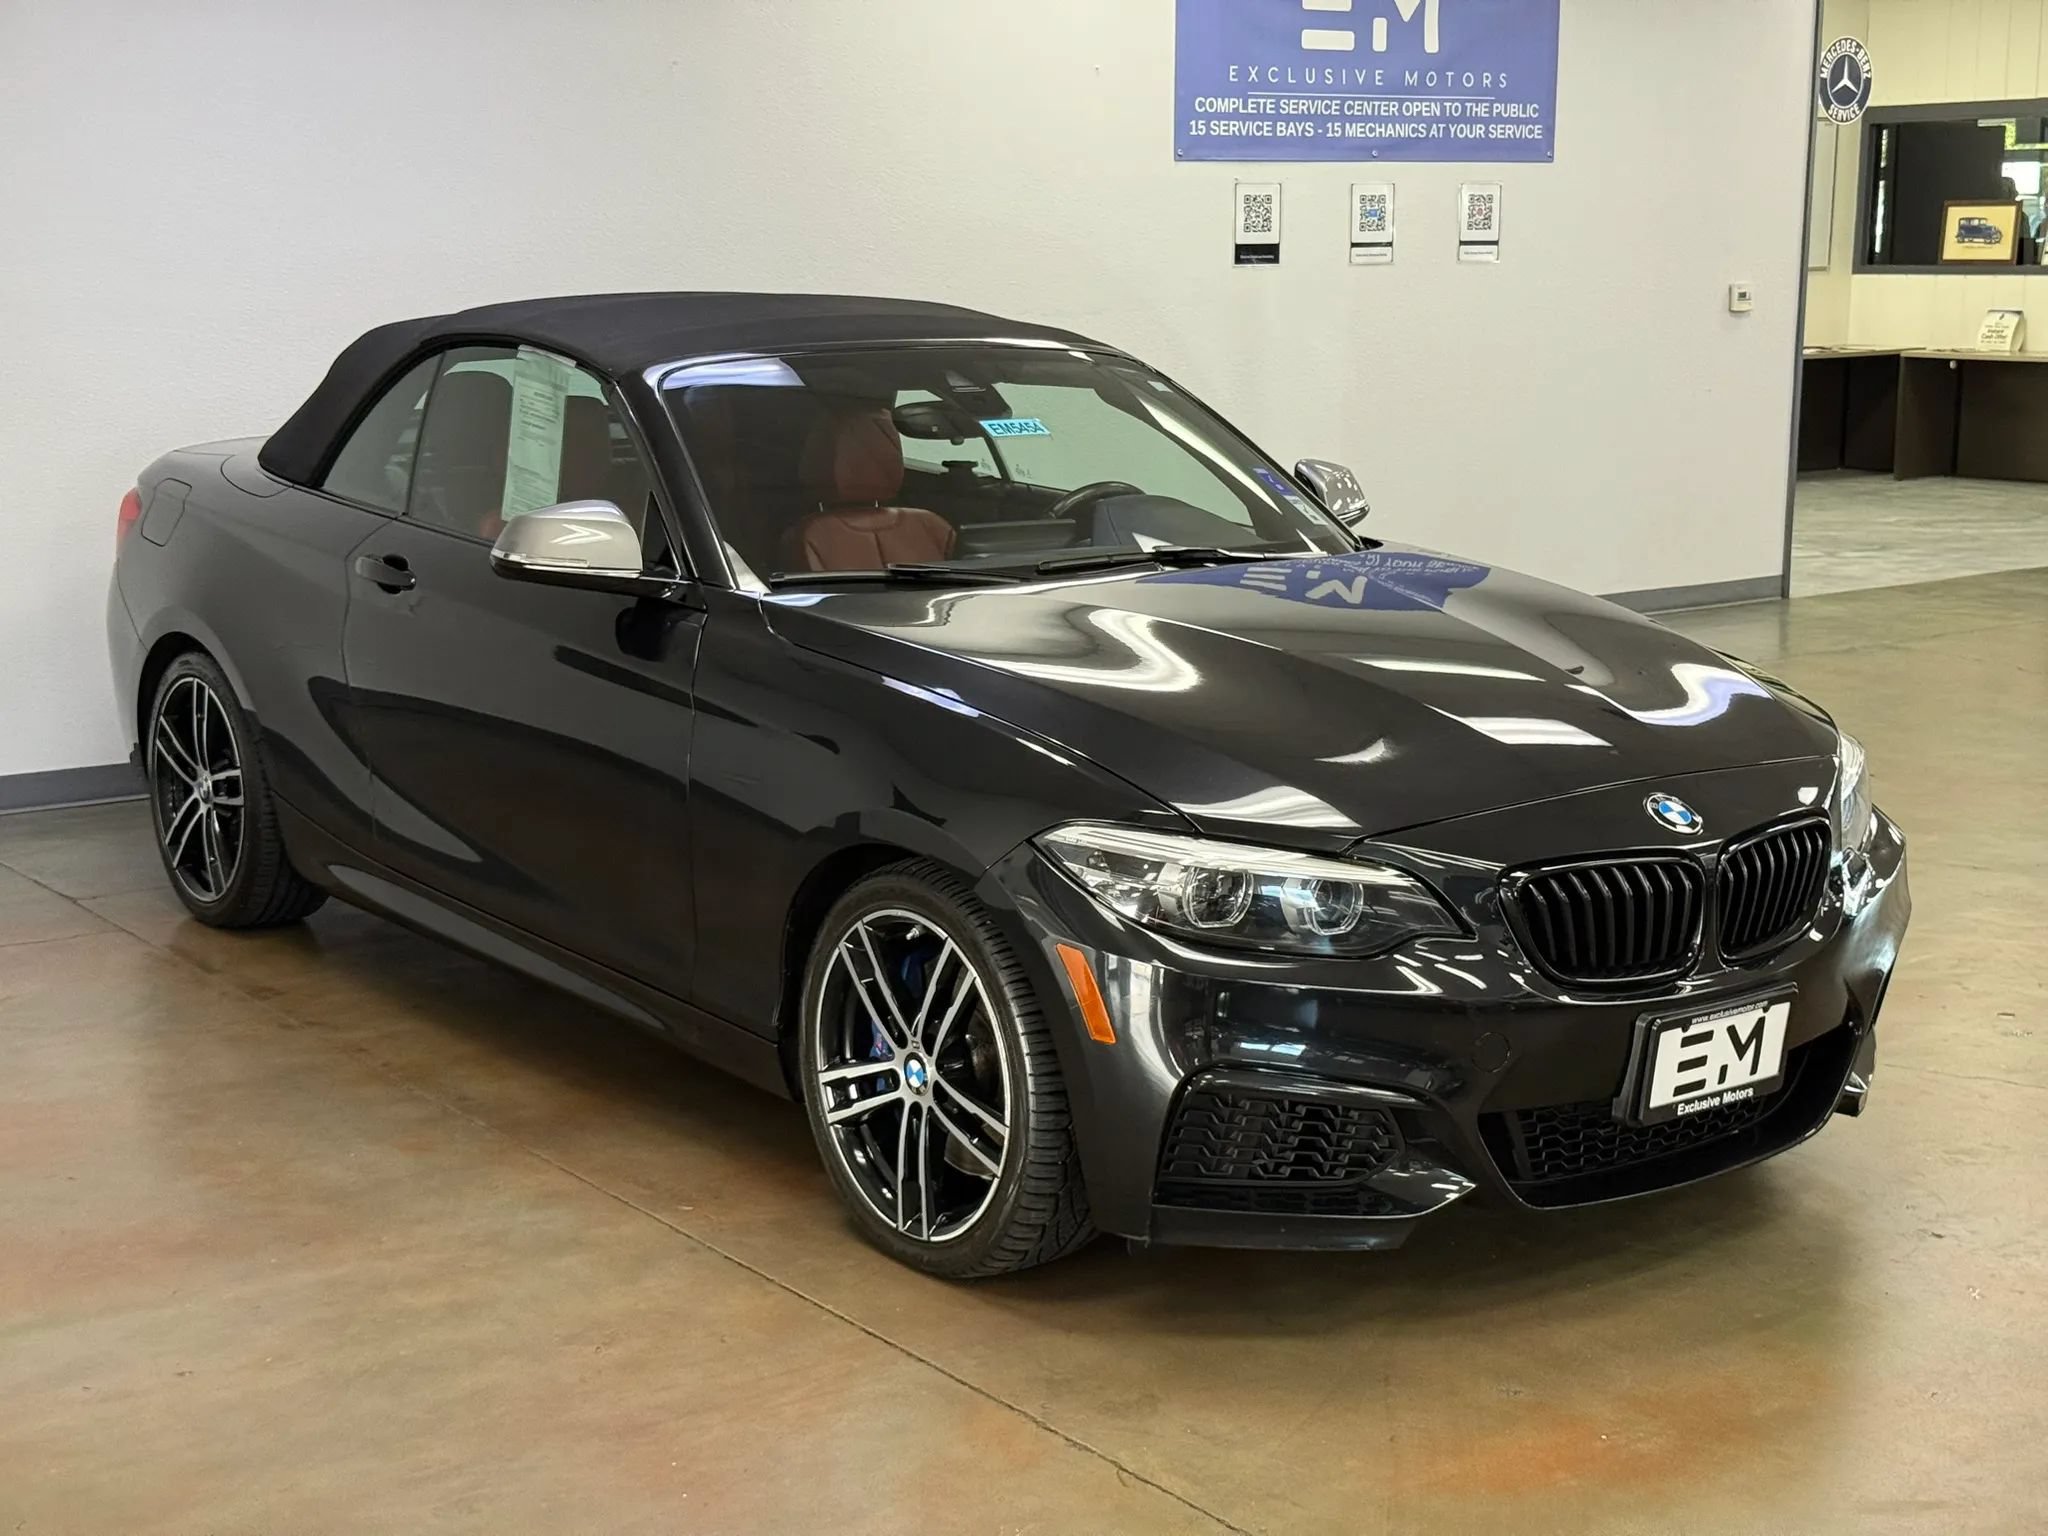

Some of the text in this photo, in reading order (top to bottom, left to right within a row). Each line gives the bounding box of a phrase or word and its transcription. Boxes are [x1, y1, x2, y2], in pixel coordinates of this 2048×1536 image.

[1229, 65, 1508, 89] EXCLUSIVE MOTORS
[1194, 97, 1539, 118] COMPLETE SERVICE CENTER OPEN TO THE PUBLIC
[1828, 103, 1860, 122] SERVICE
[1189, 120, 1206, 136] 15
[1209, 120, 1273, 137] SERVICE
[1276, 121, 1314, 137] BAYS
[1326, 122, 1342, 138] 15
[1344, 122, 1427, 138] MECHANICS
[1429, 123, 1447, 138] AT
[1448, 123, 1485, 139] YOUR
[1488, 124, 1543, 139] SERVICE
[987, 422, 1046, 435] EM5454
[1672, 1015, 1766, 1098] EM
[1677, 1087, 1754, 1116] Exclusive Motors
